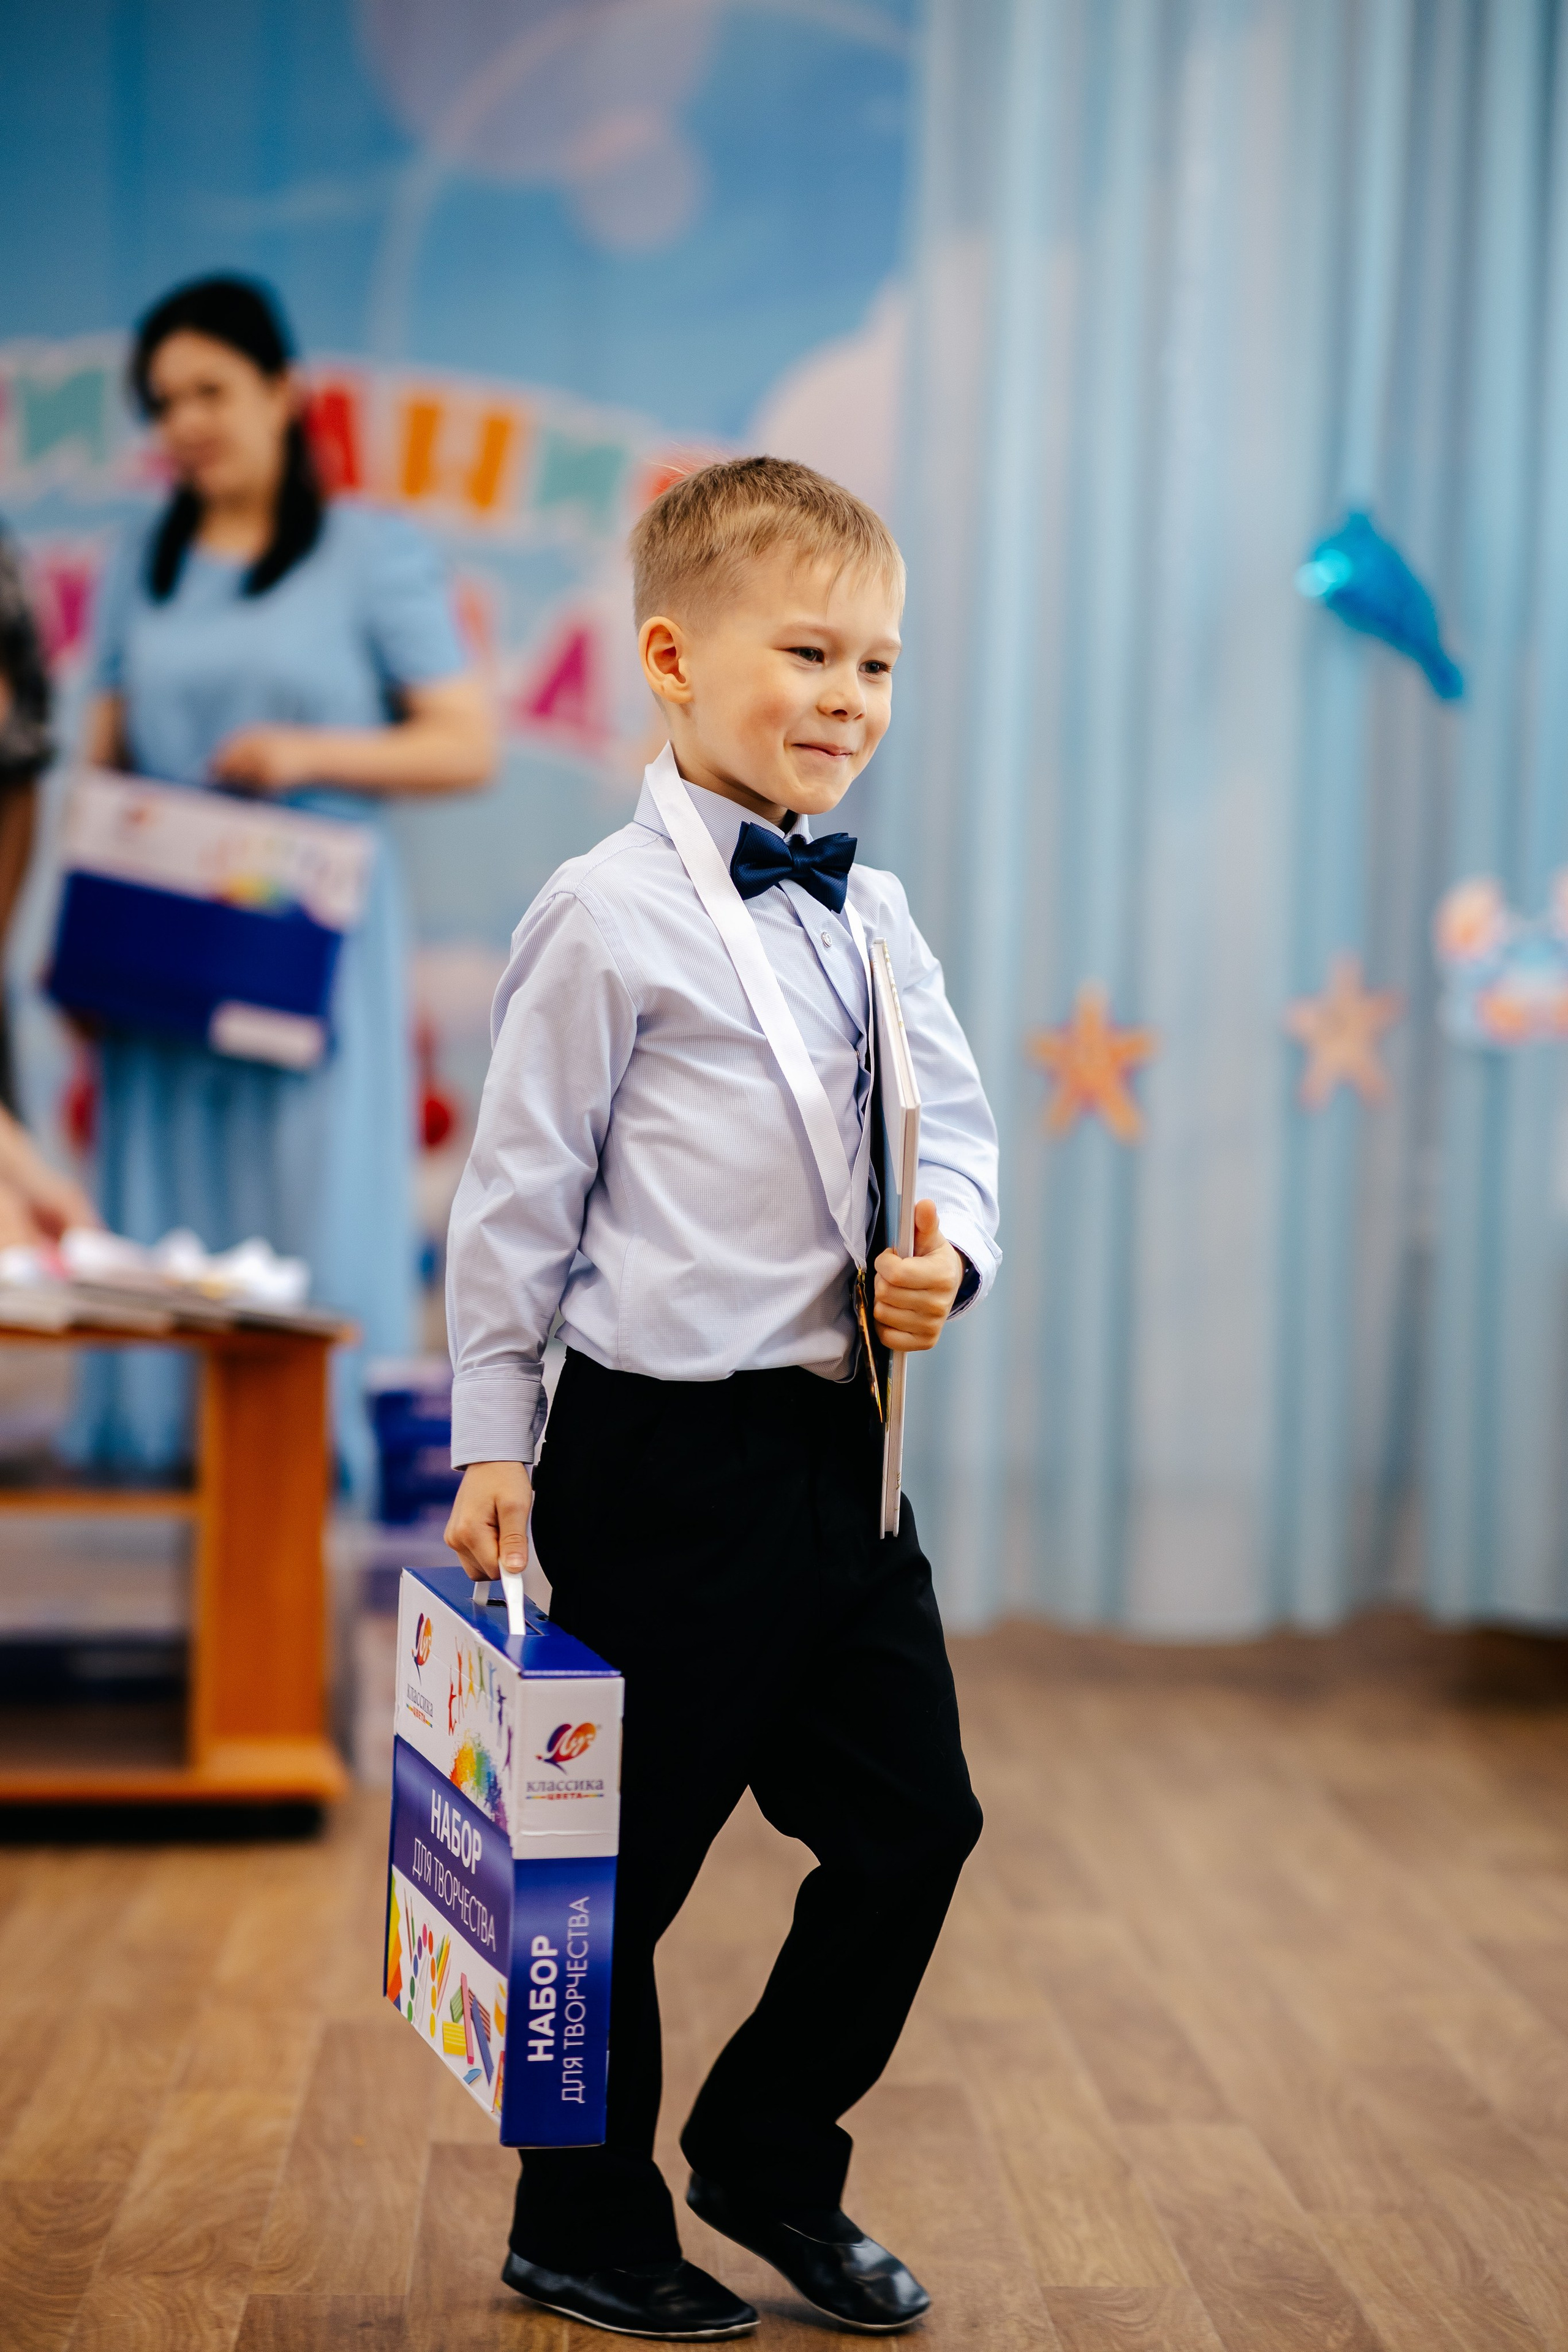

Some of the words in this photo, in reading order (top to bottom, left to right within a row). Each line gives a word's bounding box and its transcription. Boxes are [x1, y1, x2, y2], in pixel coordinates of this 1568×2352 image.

[431, 1789, 482, 1875] НАБОР
[526, 1779, 604, 1792] классика
[412, 1838, 432, 1887] ДЛЯ
[434, 1856, 496, 1953] ТВОРЧЕСТВА
[527, 1935, 558, 2062] НАБОР
[564, 1896, 590, 2050] ТВОРЧЕСТВА
[562, 2057, 586, 2103] ДЛЯ
